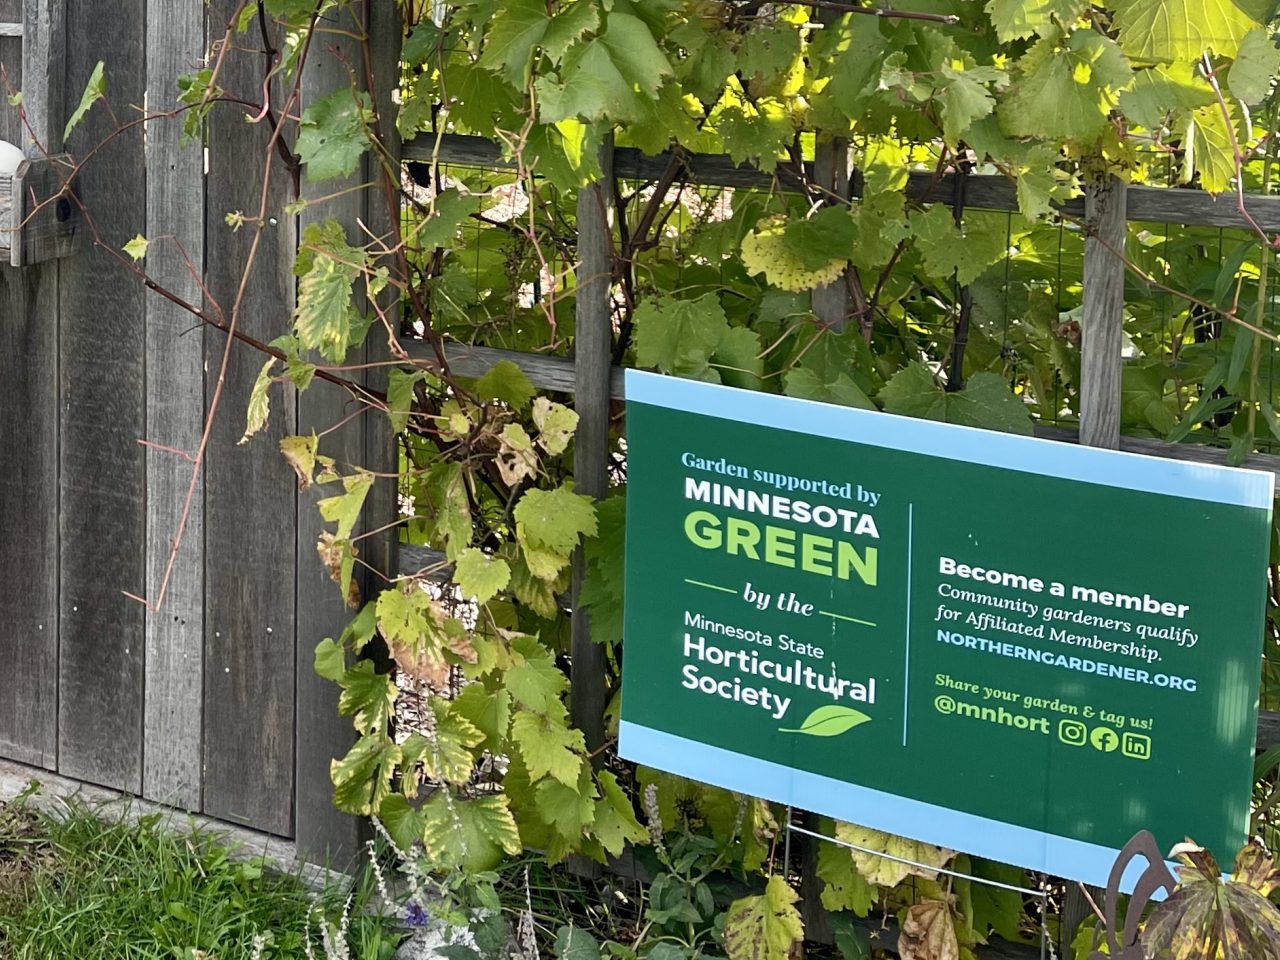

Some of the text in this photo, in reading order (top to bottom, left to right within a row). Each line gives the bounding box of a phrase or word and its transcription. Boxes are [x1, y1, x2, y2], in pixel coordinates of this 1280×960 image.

[681, 452, 881, 507] Garden supported by
[685, 477, 880, 539] MINNESOTA
[684, 510, 878, 586] GREEN
[743, 583, 814, 617] by the
[938, 583, 1199, 648] Community gardeners qualify
[939, 556, 1190, 619] Become a member
[684, 610, 825, 659] Minnesota State
[934, 605, 1163, 663] for Affiliated Membership.
[936, 629, 1197, 692] NORTHERNGARDENER.ORG
[682, 664, 792, 720] Society
[683, 633, 876, 704] Horticultural
[934, 695, 1050, 735] @mnhort
[935, 673, 1153, 730] Share your garden & tag us!
